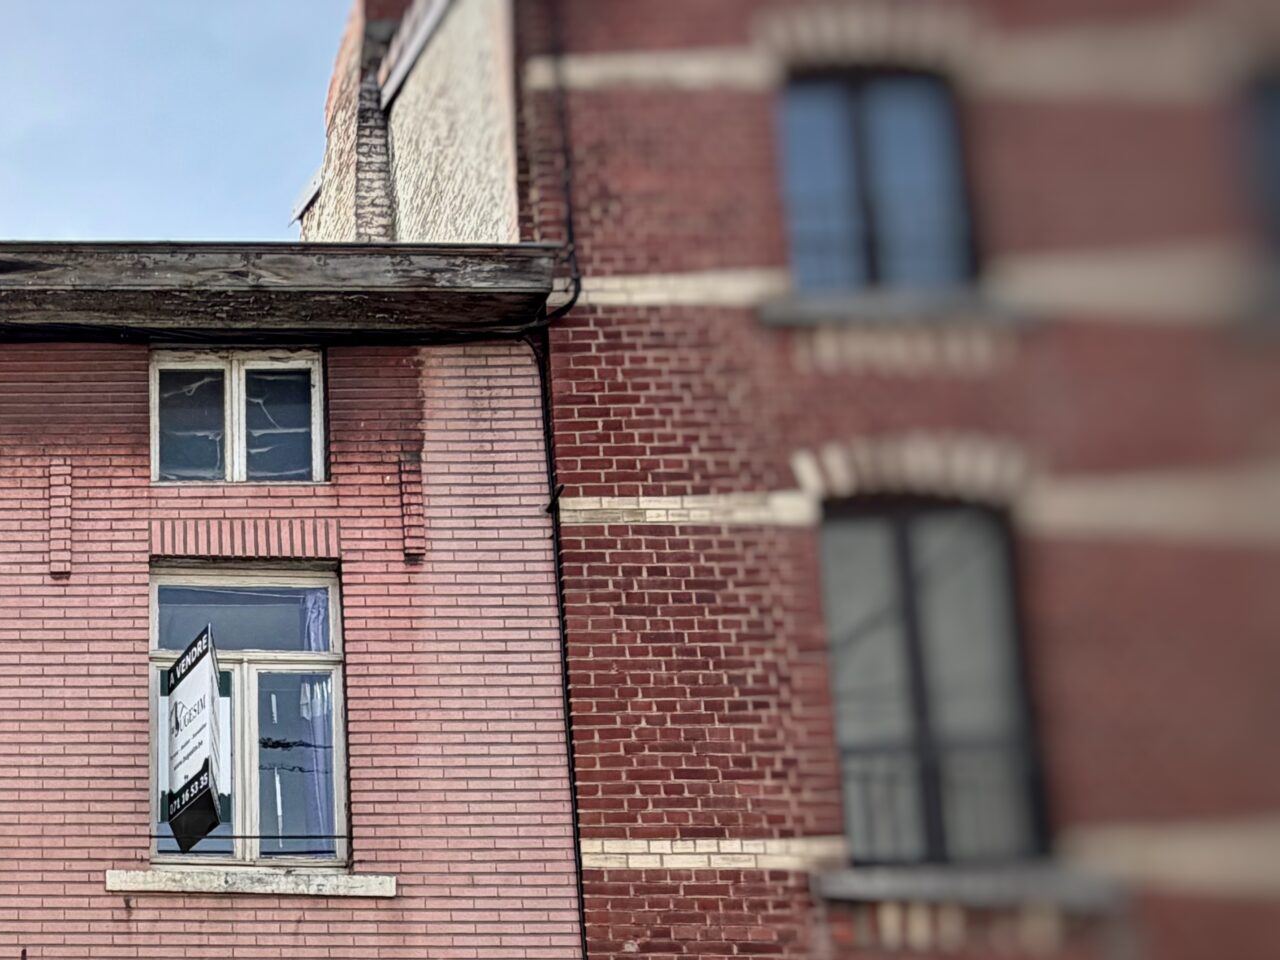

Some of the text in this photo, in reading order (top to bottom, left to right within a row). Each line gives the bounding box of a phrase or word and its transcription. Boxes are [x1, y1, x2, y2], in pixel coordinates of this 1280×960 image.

[169, 634, 208, 688] A VENDRE
[170, 772, 208, 815] 071 16 53 35
